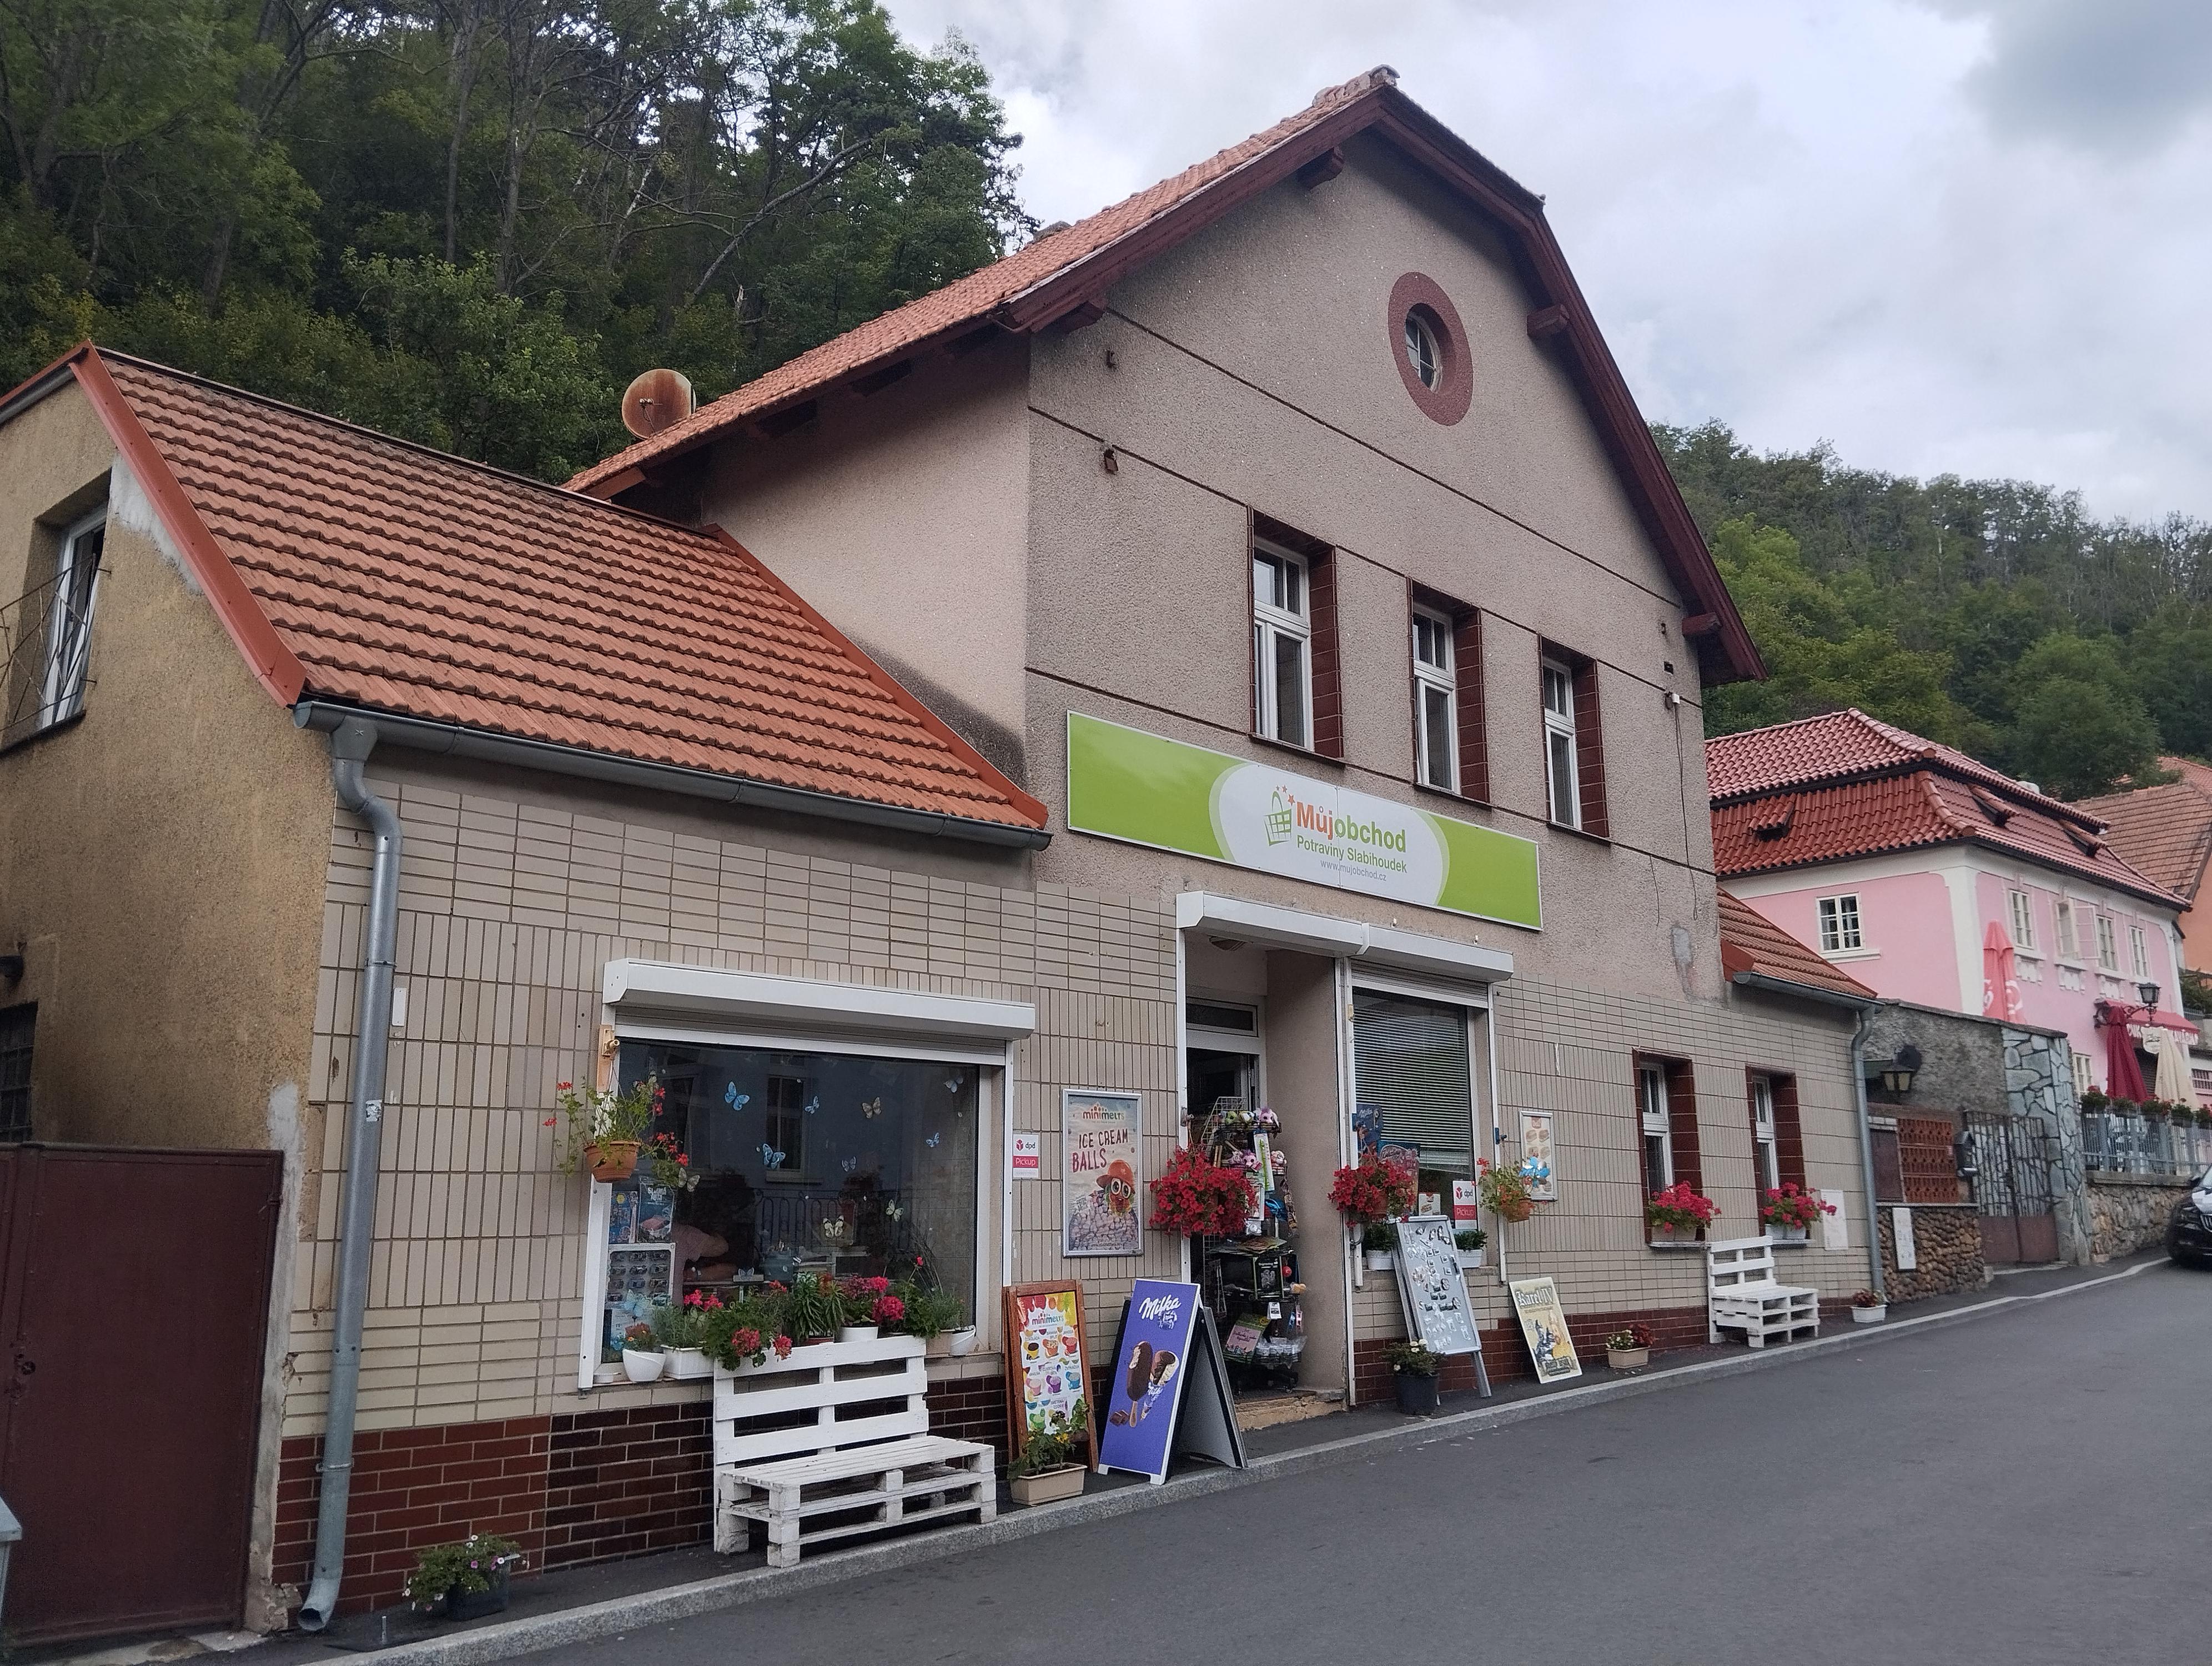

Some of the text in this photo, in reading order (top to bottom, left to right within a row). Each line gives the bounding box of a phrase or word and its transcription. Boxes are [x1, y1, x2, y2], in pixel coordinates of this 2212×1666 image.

[1296, 801, 1406, 853] Můjobchod
[1297, 835, 1407, 874] Potraviny Slabihoudek
[1320, 860, 1387, 881] www.mujobchod.cz
[1025, 1142, 1036, 1150] dpd
[1079, 1128, 1128, 1149] ICE CREAM
[1015, 1157, 1036, 1167] Pickup
[1072, 1148, 1107, 1173] BALLS
[1464, 1189, 1474, 1198] dpd
[1138, 1294, 1182, 1321] Milka
[1515, 1289, 1542, 1307] Karel
